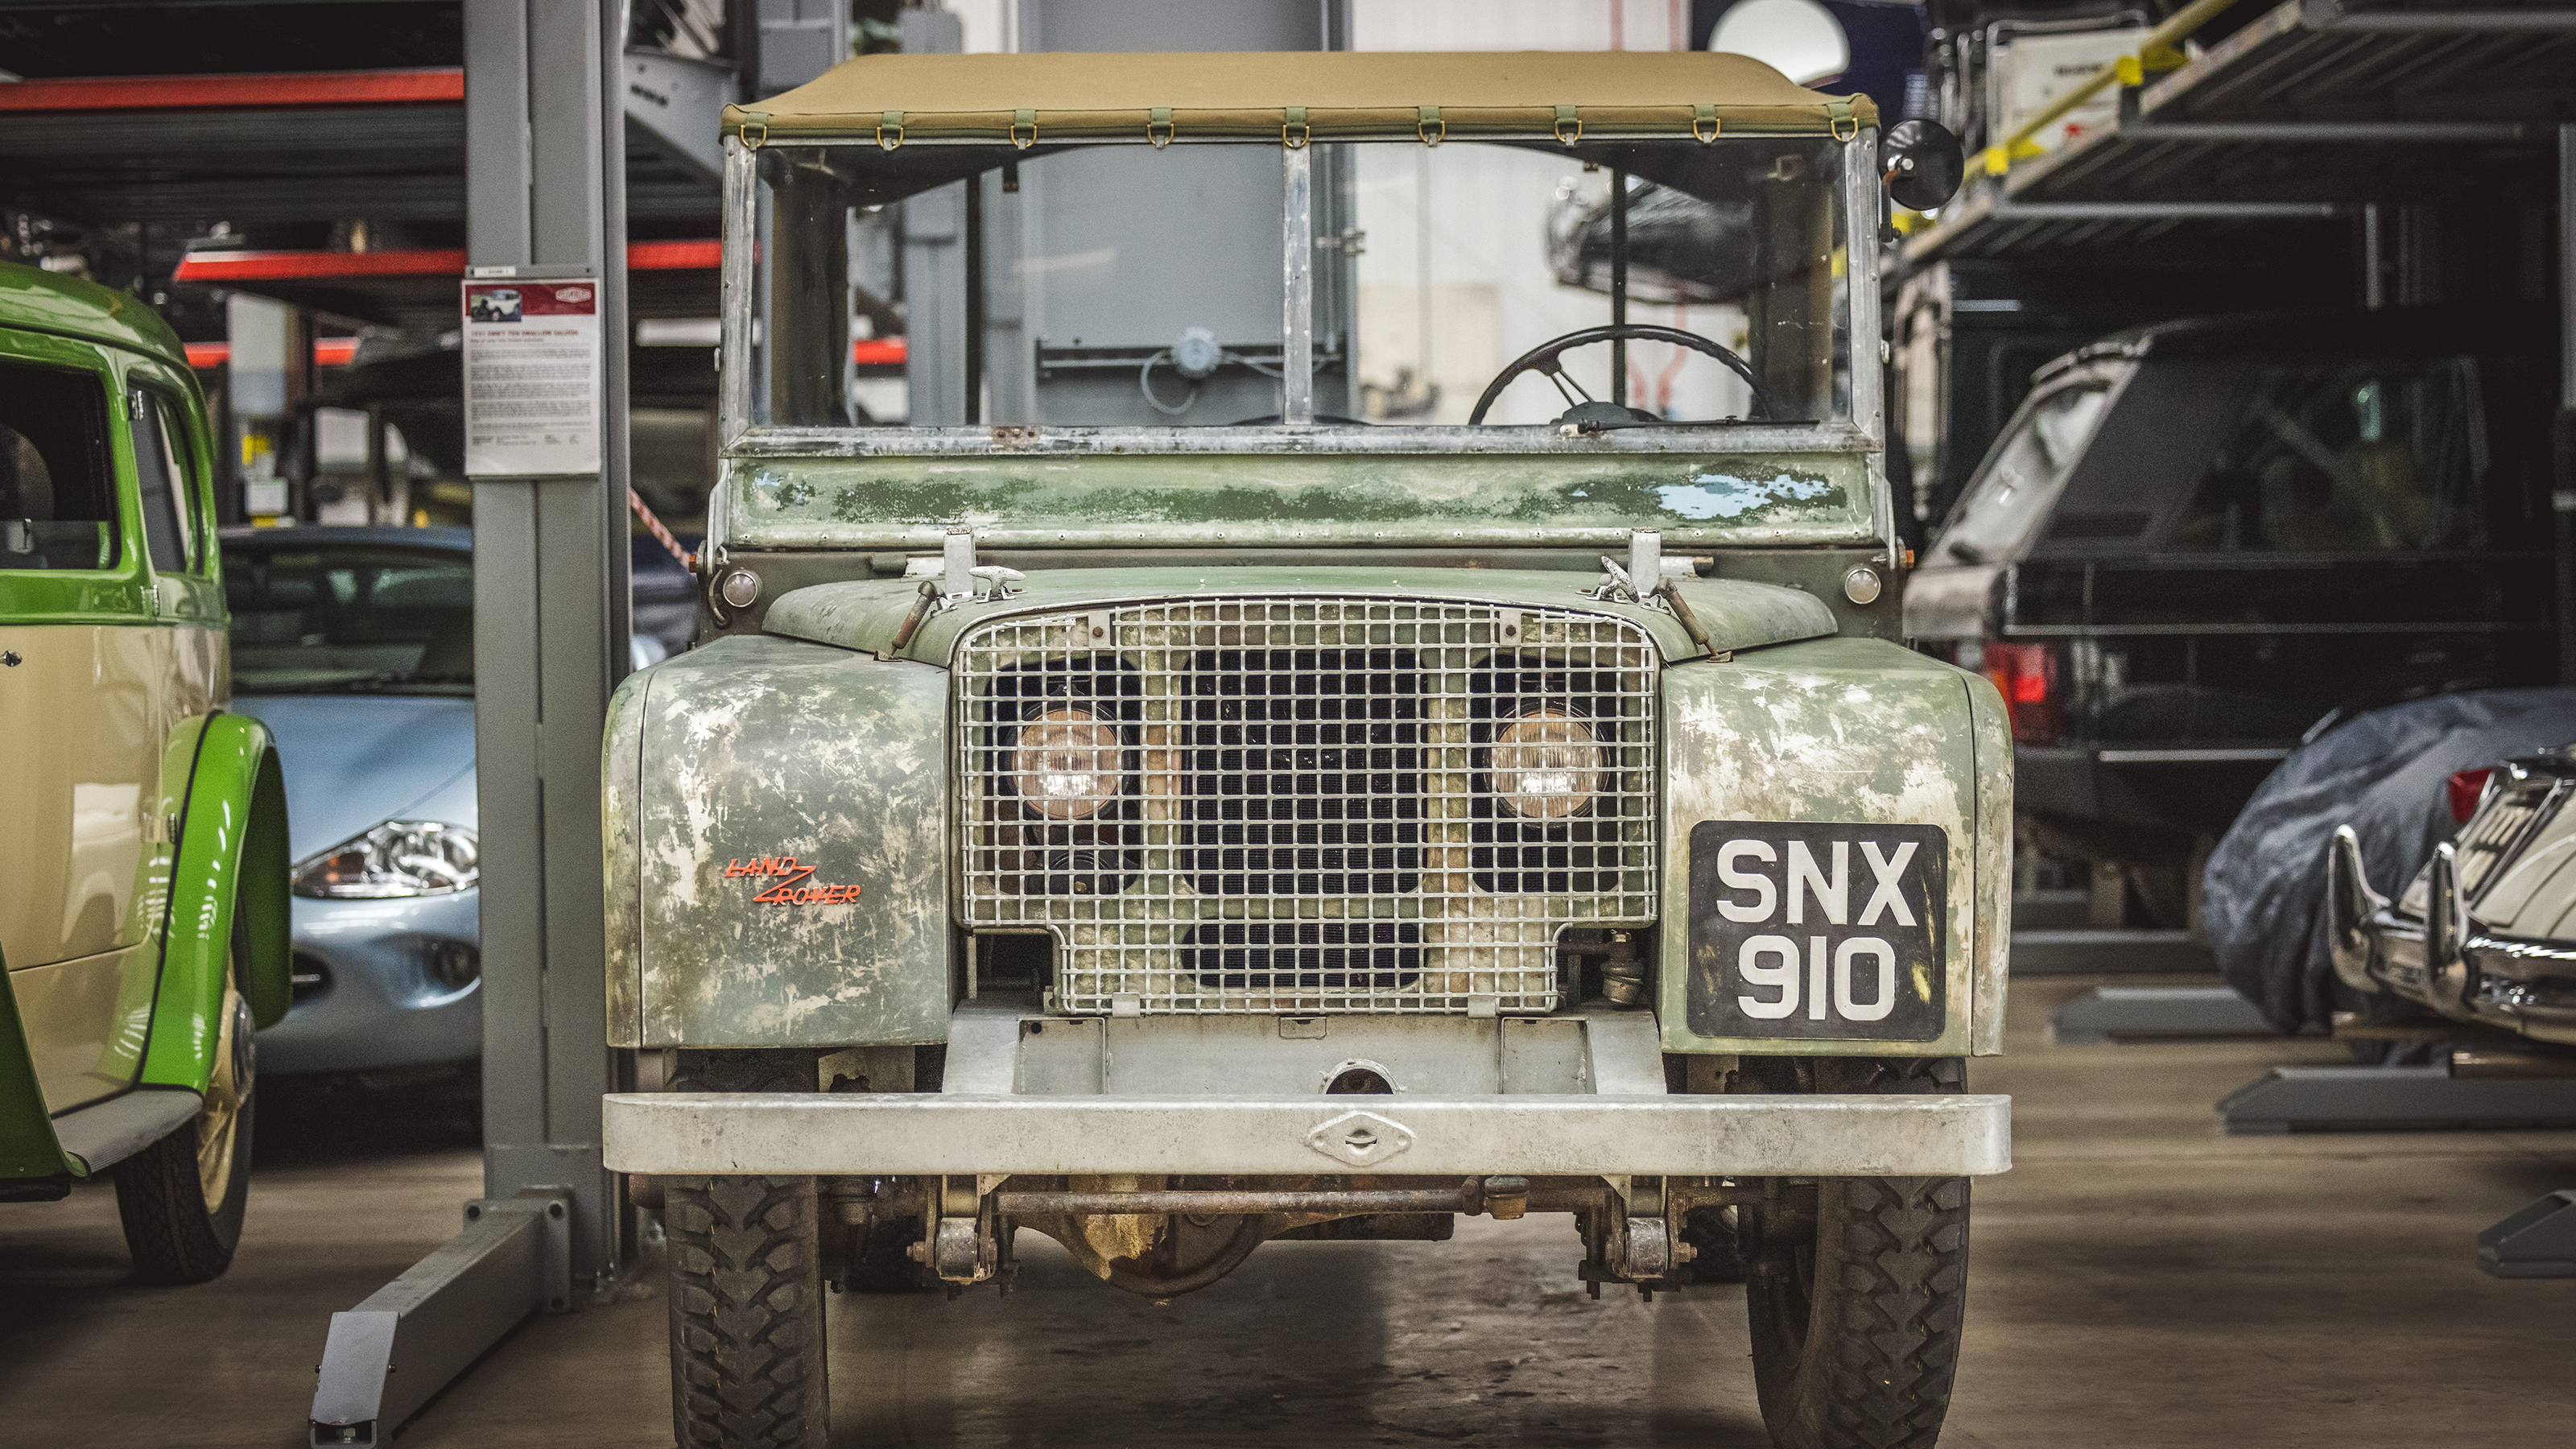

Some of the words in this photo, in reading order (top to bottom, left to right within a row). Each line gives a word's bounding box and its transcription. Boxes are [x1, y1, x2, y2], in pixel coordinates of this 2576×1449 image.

[725, 857, 797, 877] LAND
[1716, 839, 1919, 927] SNX
[772, 885, 861, 906] ROVER
[1737, 935, 1896, 1022] 910
